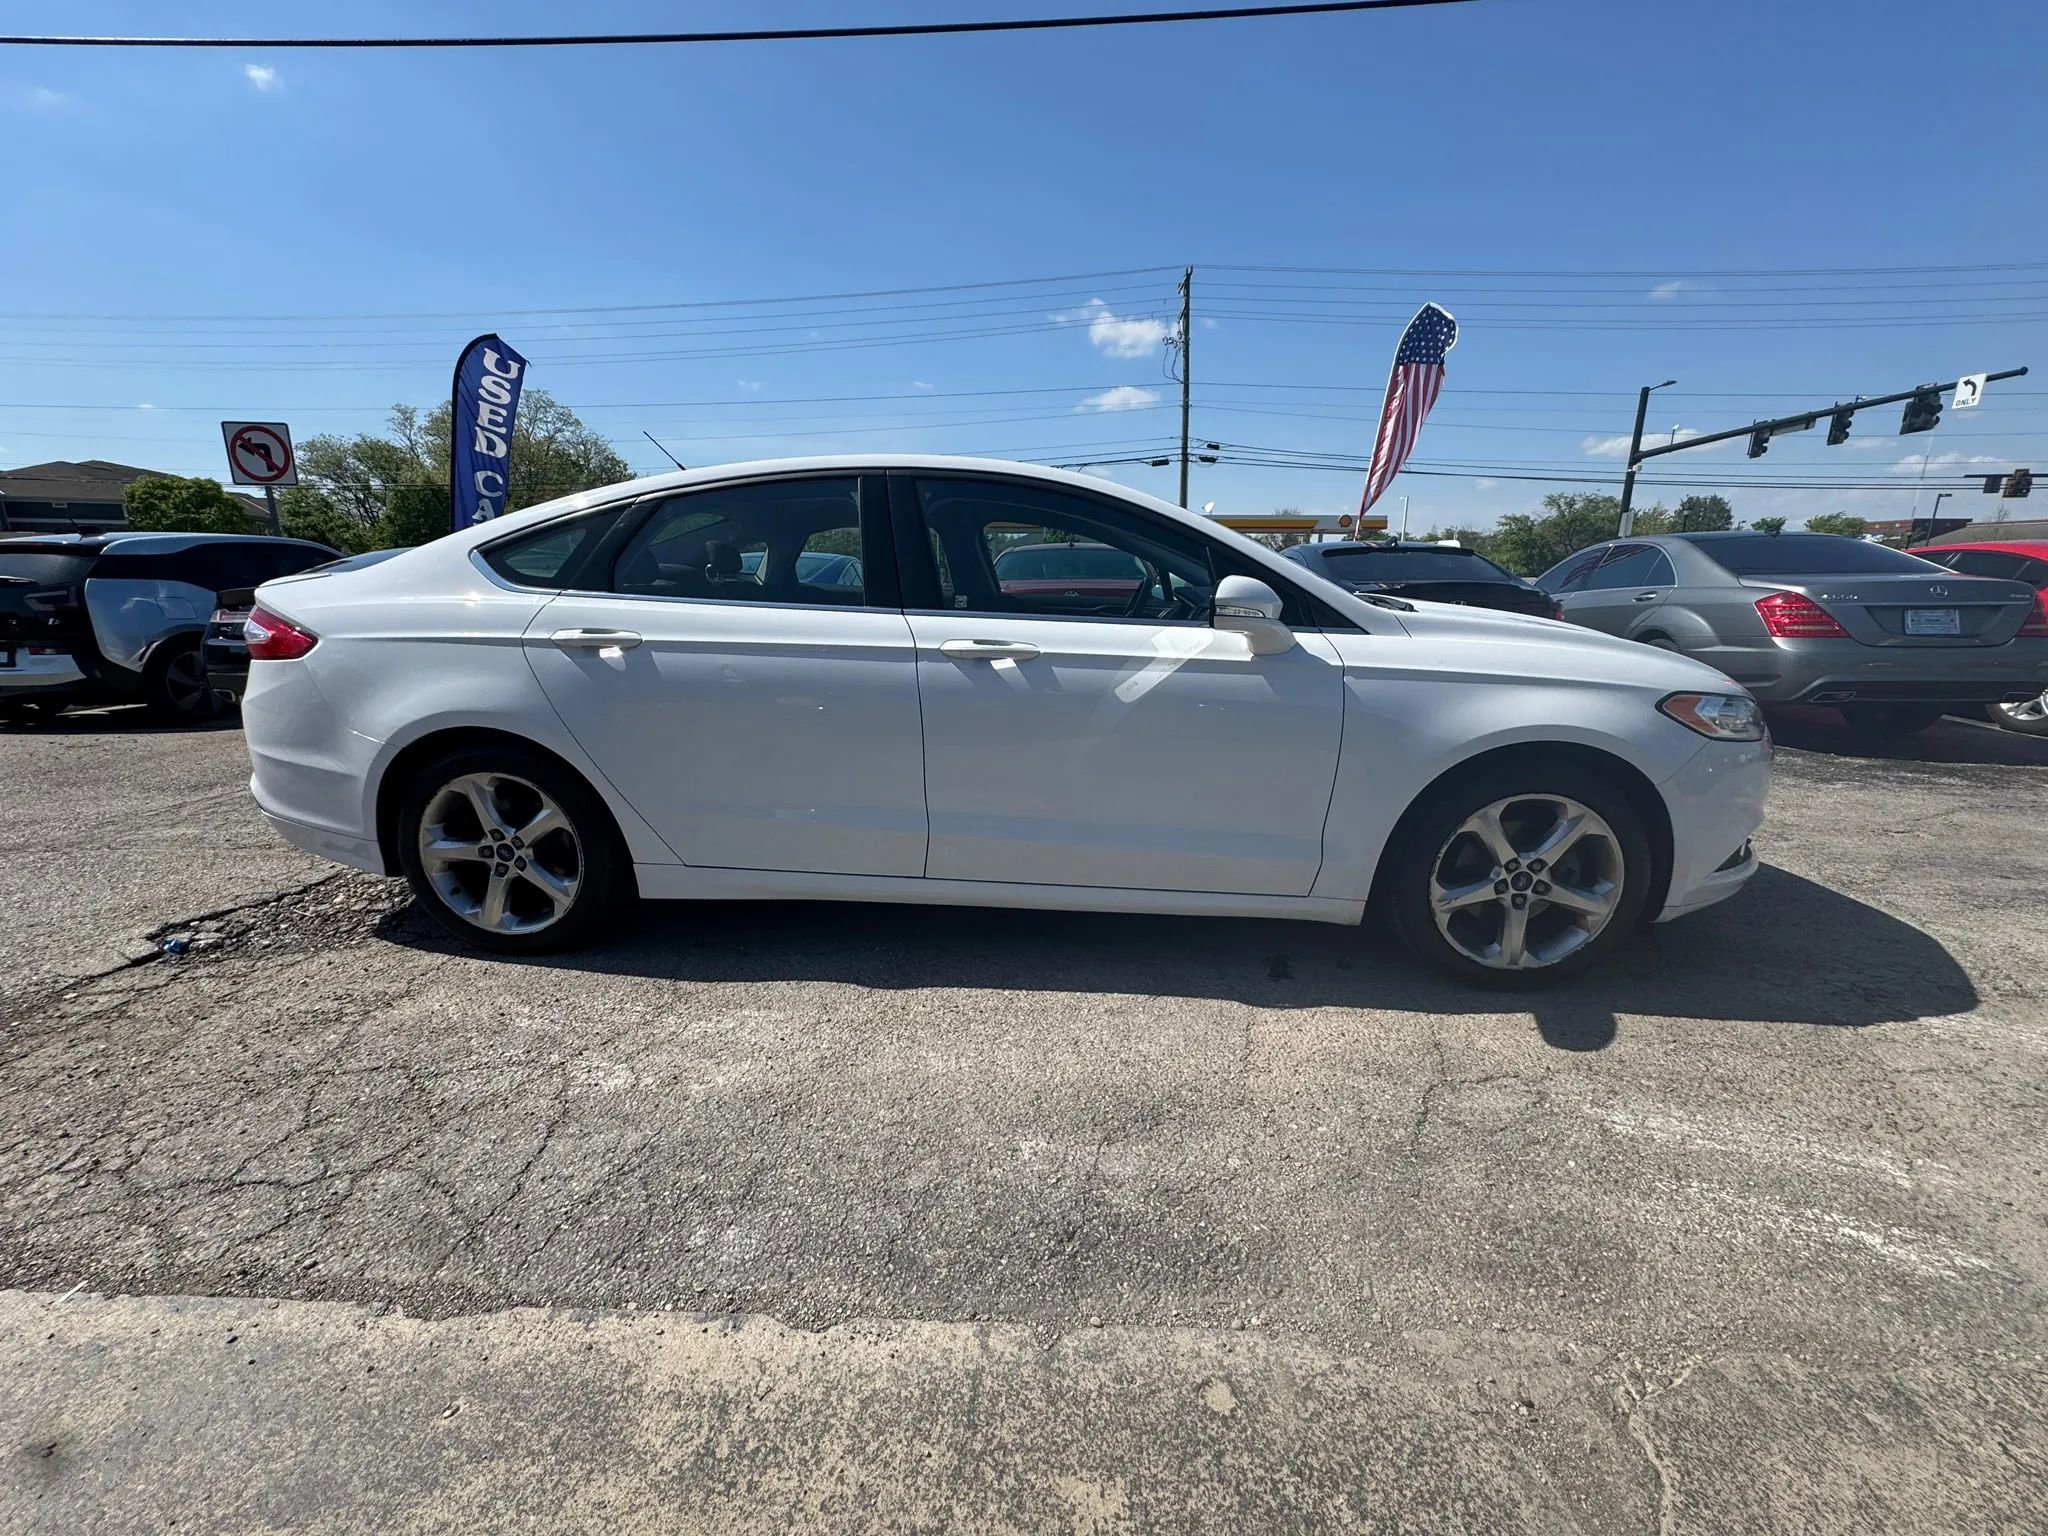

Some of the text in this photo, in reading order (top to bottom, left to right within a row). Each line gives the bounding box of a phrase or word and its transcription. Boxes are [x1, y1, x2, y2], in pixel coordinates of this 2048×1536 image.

[472, 348, 520, 526] USED CA
[1955, 397, 1976, 406] ONLY
